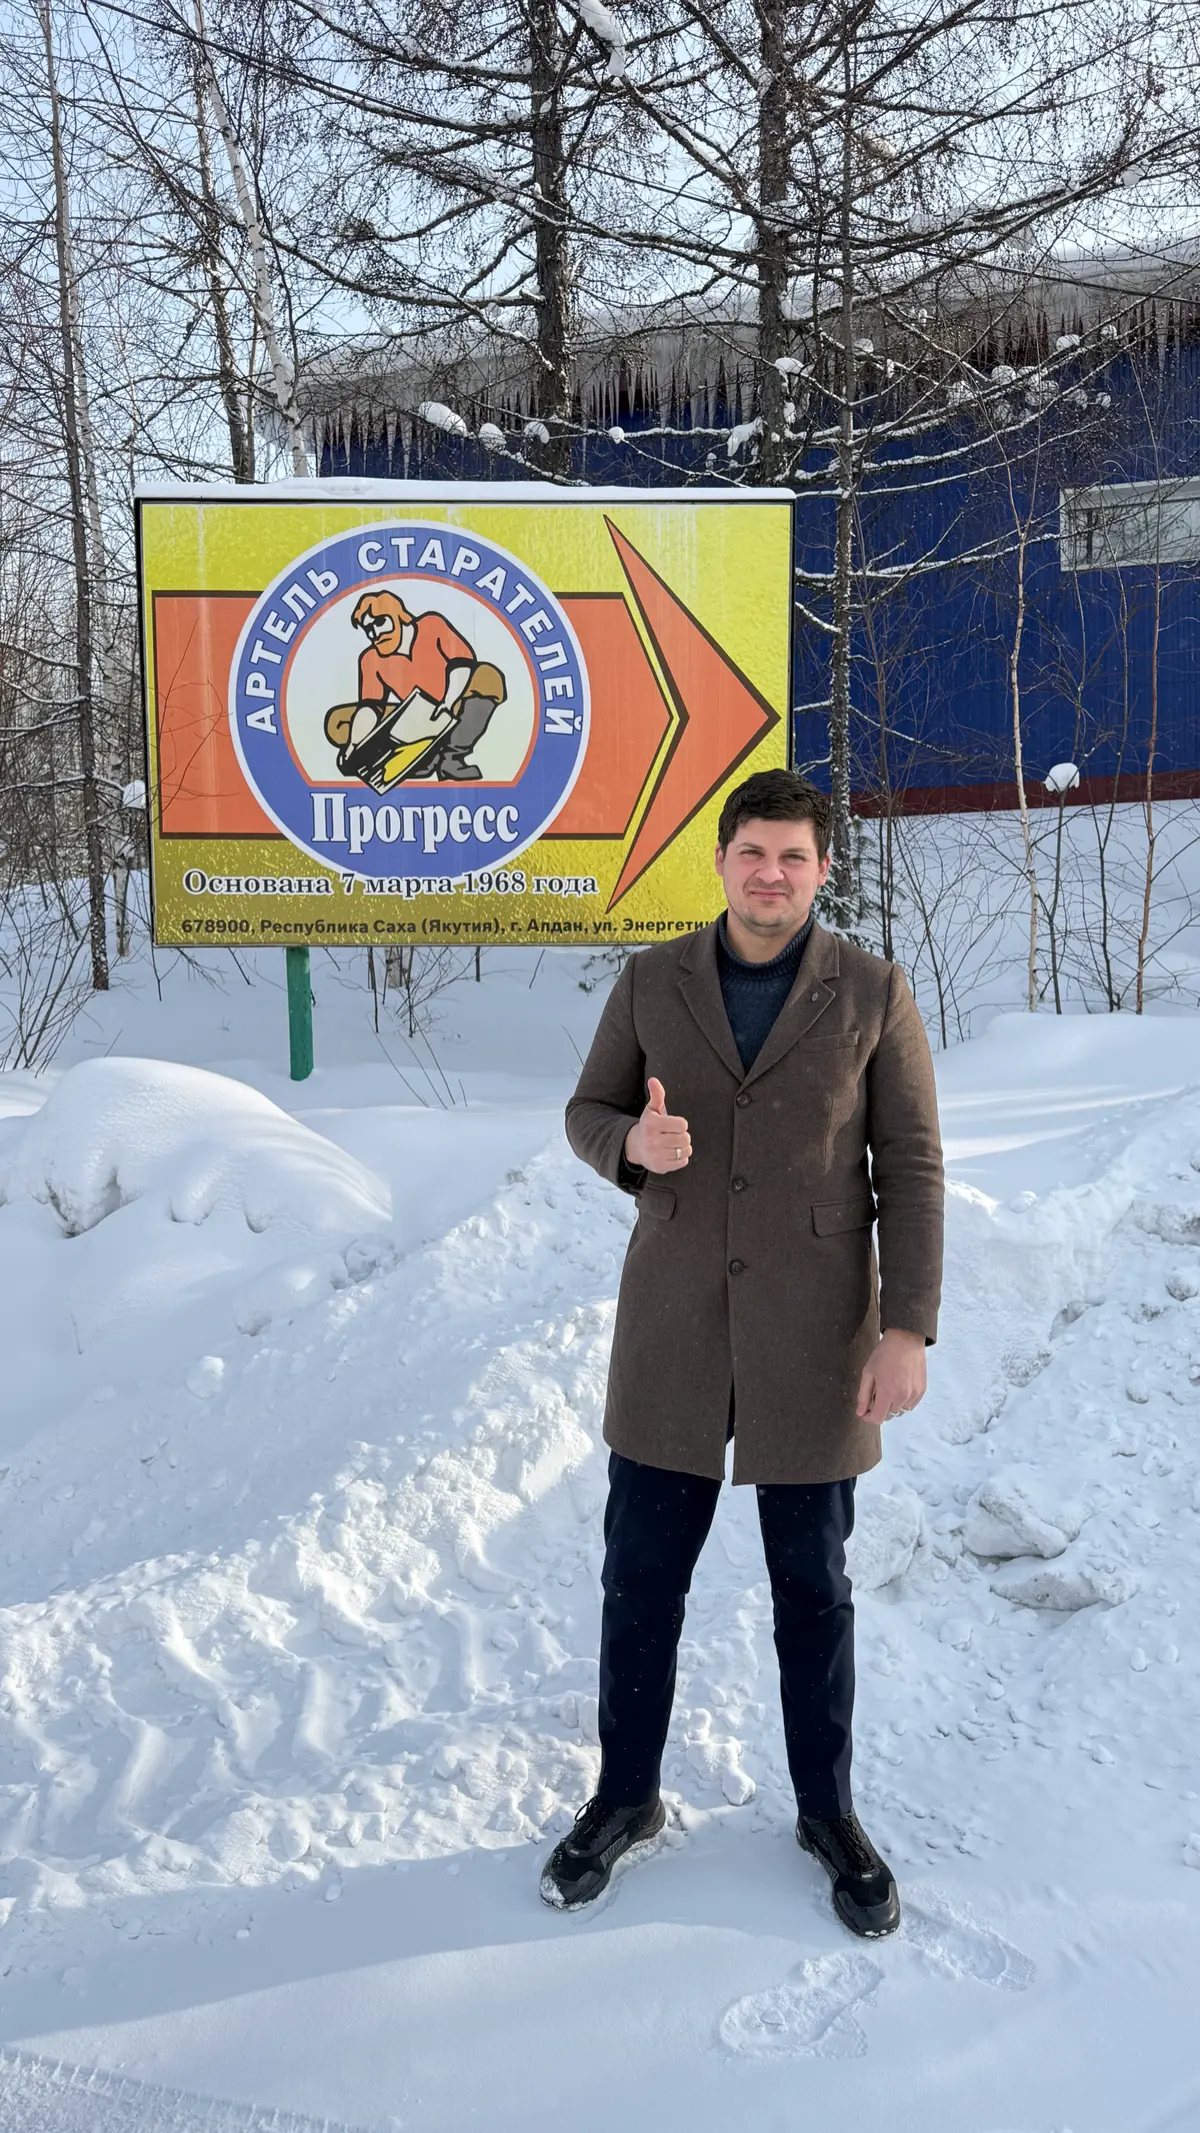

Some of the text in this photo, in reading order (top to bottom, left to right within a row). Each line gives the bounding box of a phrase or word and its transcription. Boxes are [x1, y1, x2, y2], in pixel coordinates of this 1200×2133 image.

[244, 536, 583, 736] АРТЕЛЬ СТАРАТЕЛЕЙ
[310, 792, 520, 854] Прогресс
[184, 870, 598, 899] Основана 7 марта 1968 года
[181, 919, 256, 935] 678900,
[260, 919, 370, 936] Республика
[373, 919, 417, 934] Саха
[421, 918, 505, 936] (Якутия),
[510, 921, 522, 933] г.
[527, 918, 589, 934] Алдан,
[593, 920, 618, 934] ул.
